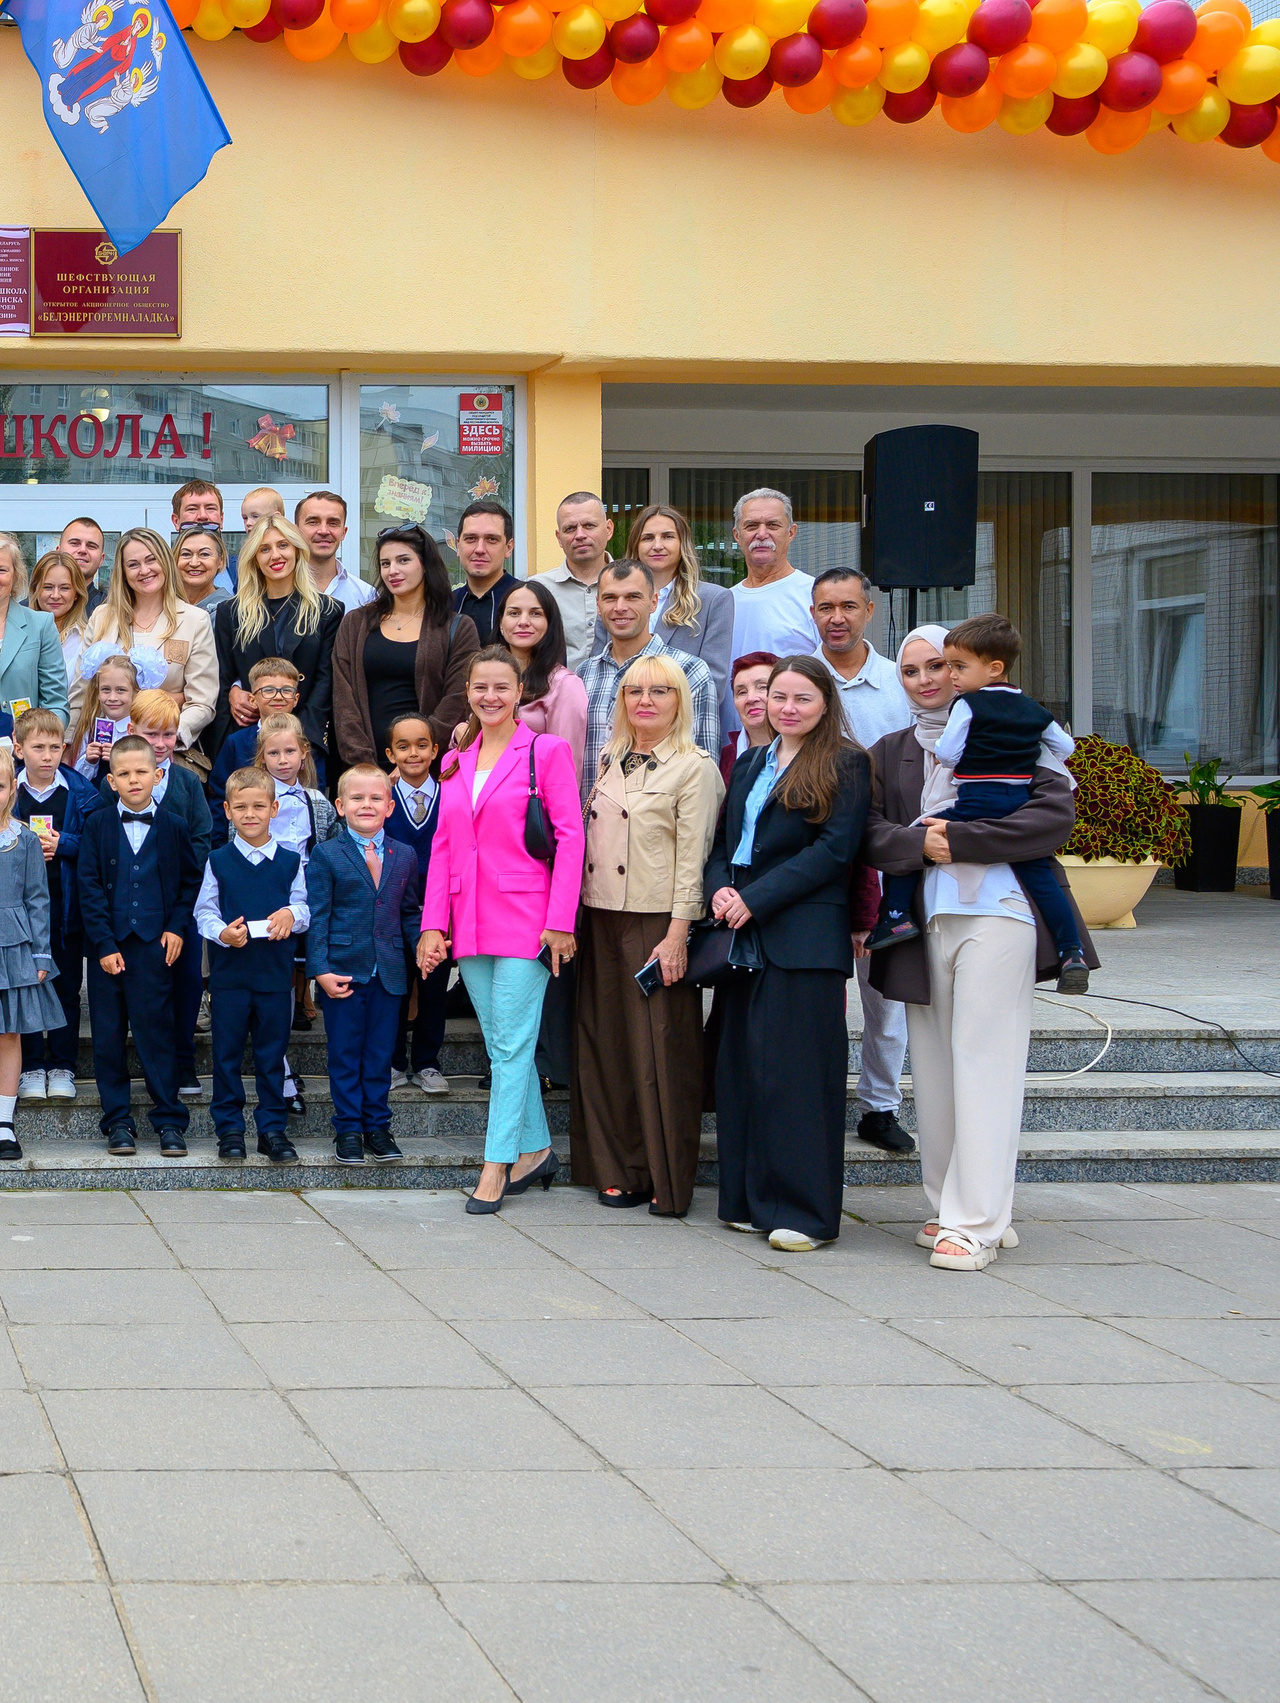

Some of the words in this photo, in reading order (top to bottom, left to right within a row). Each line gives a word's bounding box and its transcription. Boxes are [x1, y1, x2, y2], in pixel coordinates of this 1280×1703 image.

[56, 273, 156, 283] ШЕФСТВУЮЩАЯ
[62, 285, 150, 295] ОРГАНИЗАЦИЯ
[37, 312, 175, 323] «БЕЛЭНЕРГОРЕМНАЛАДКА»
[462, 425, 500, 436] ЗДЕСЬ
[462, 445, 501, 453] МИЛИЦИЮ
